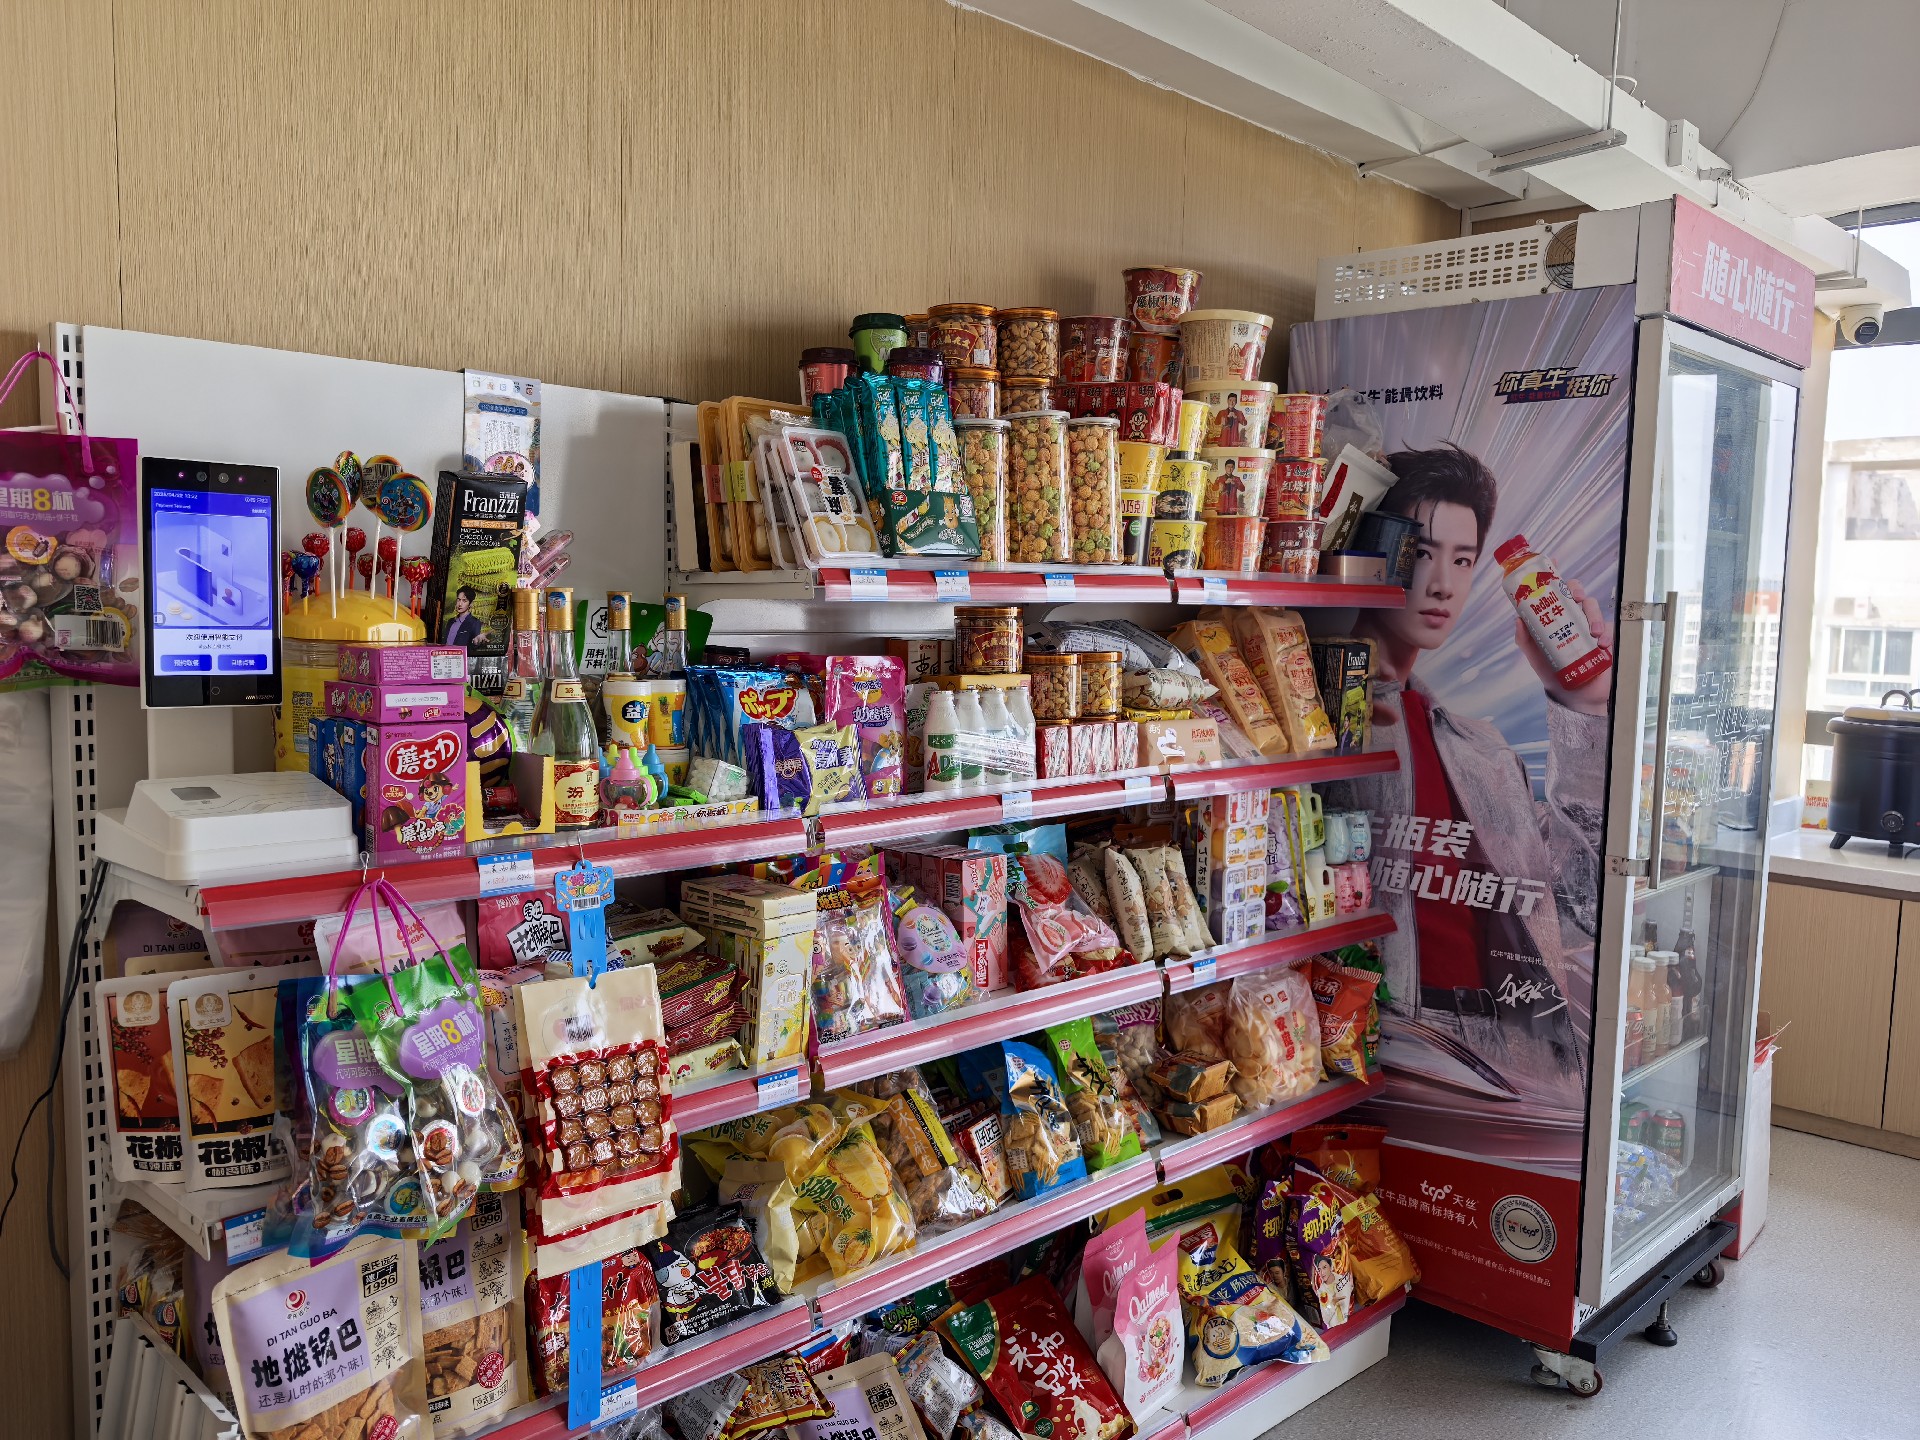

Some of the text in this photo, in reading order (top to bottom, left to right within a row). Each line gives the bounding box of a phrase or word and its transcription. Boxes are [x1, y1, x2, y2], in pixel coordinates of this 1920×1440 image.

[1696, 240, 1797, 335] 随心随行
[463, 490, 520, 514] Franzzi
[1539, 605, 1564, 628] 红牛
[395, 738, 455, 775] 蘑古力
[1370, 856, 1546, 917] 随心随行
[412, 1013, 474, 1057] 星期8杯
[889, 1098, 938, 1174] 口水小麻花
[1375, 1186, 1479, 1230] 红牛品牌商标持有人
[1420, 1180, 1477, 1212] tcp 天丝
[474, 1213, 500, 1229] 1996
[365, 1276, 397, 1297] 1996
[697, 1259, 747, 1301] 불닭
[1129, 1276, 1170, 1321] Oatmeal
[266, 1308, 338, 1347] DI TAN GUO BA
[1208, 1319, 1226, 1329] 12.6
[251, 1318, 363, 1390] 地摊锅巴
[873, 1399, 896, 1414] 1996
